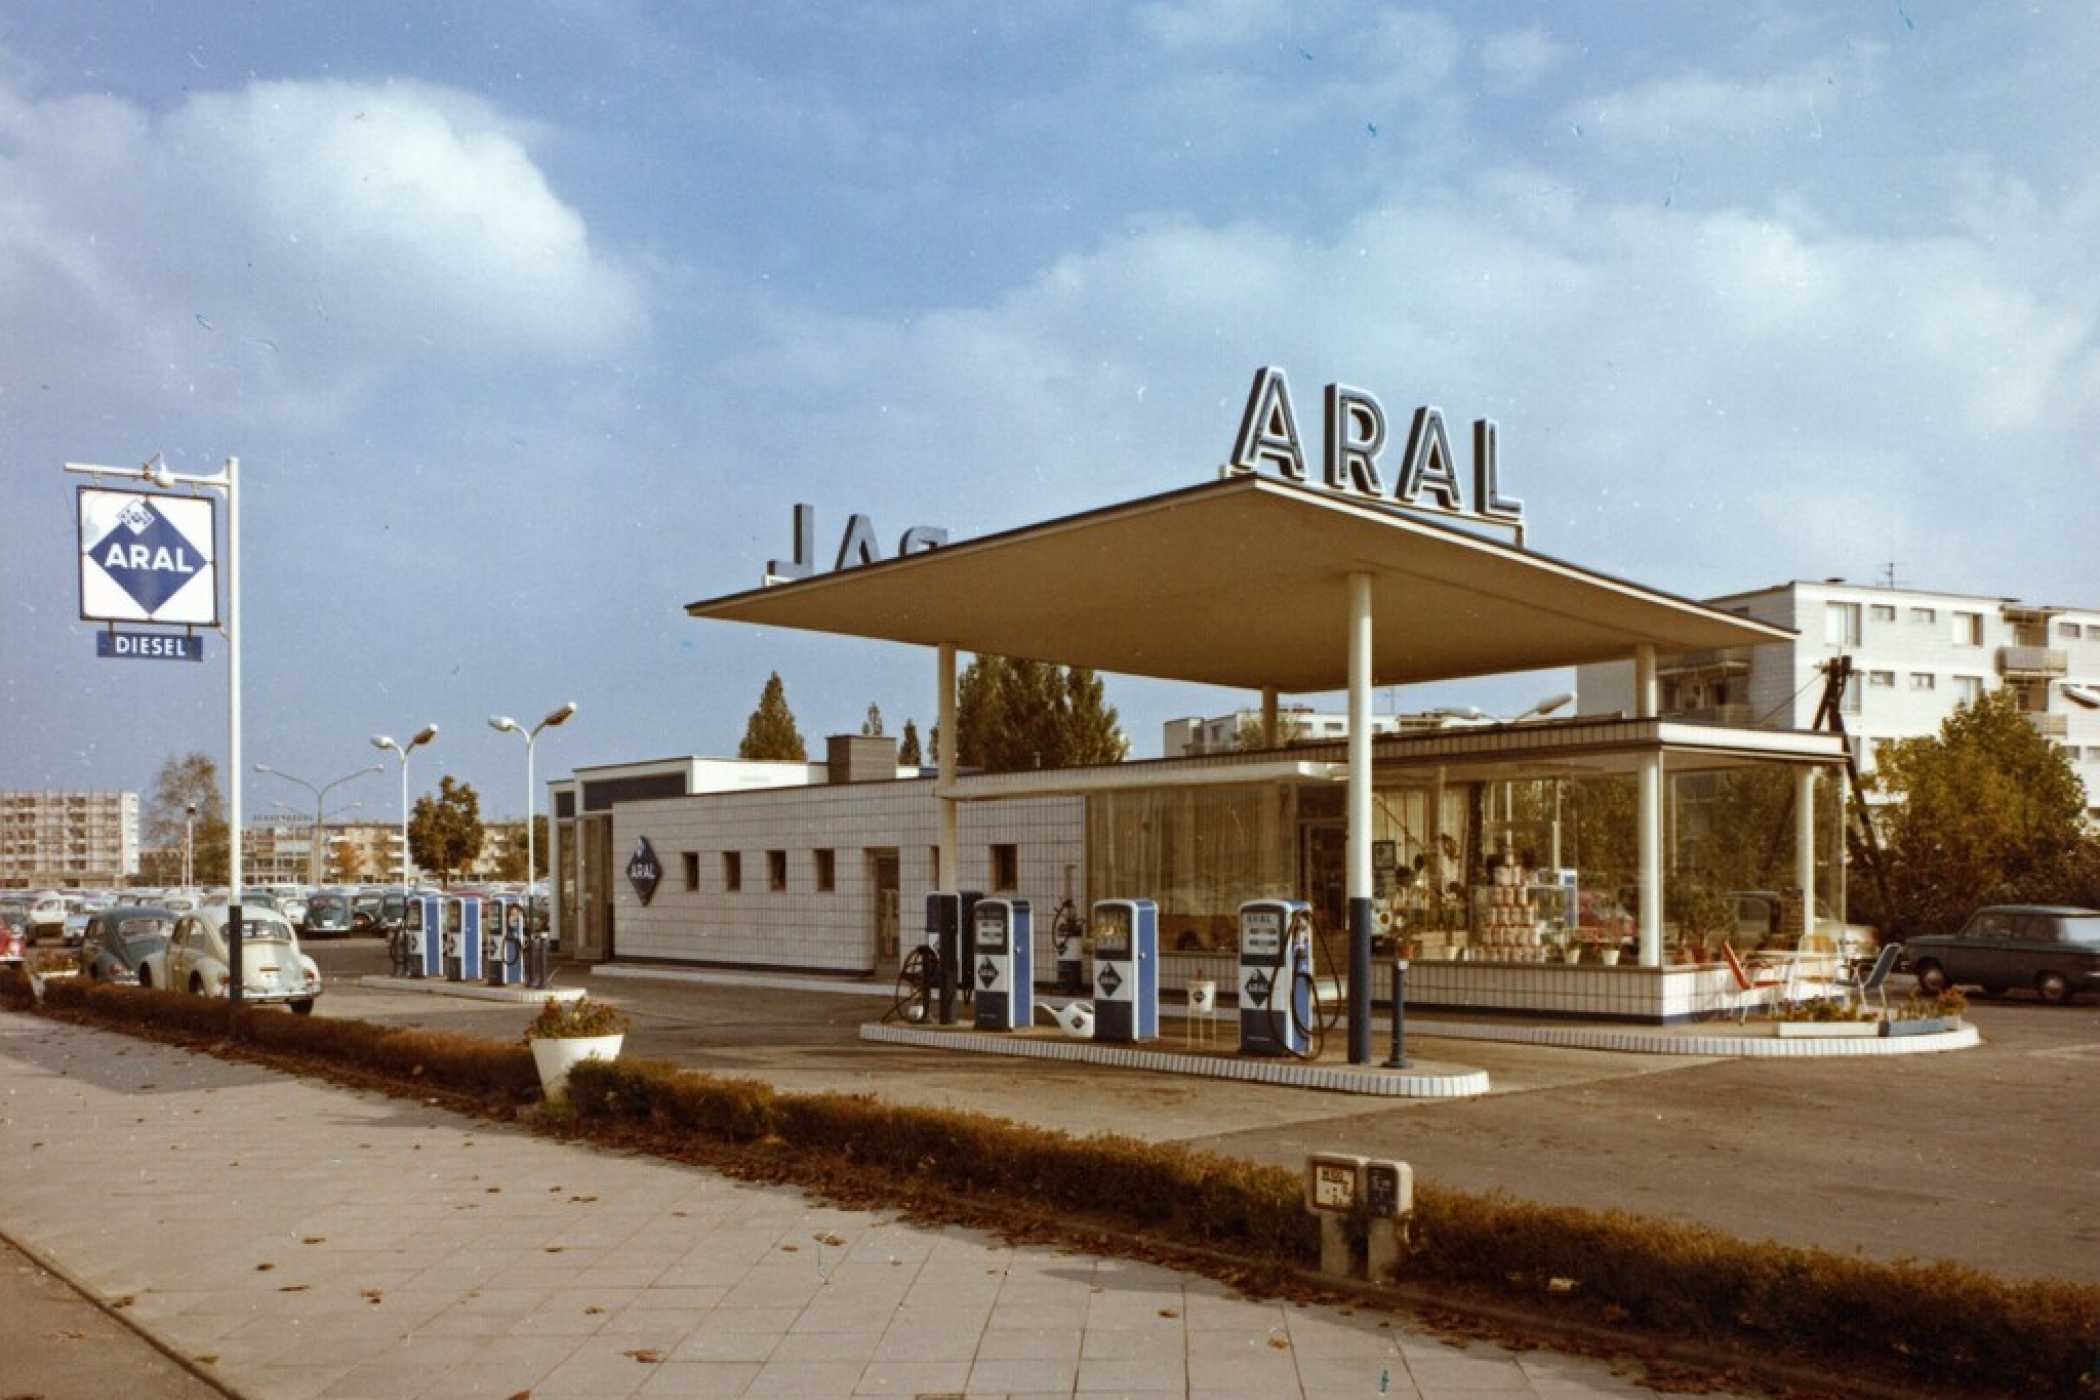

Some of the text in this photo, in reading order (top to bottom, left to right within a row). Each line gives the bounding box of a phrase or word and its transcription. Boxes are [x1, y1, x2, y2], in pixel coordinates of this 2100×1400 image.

[1230, 365, 1525, 516] ARAL
[104, 542, 194, 573] ARAL
[115, 636, 187, 657] DIESEL
